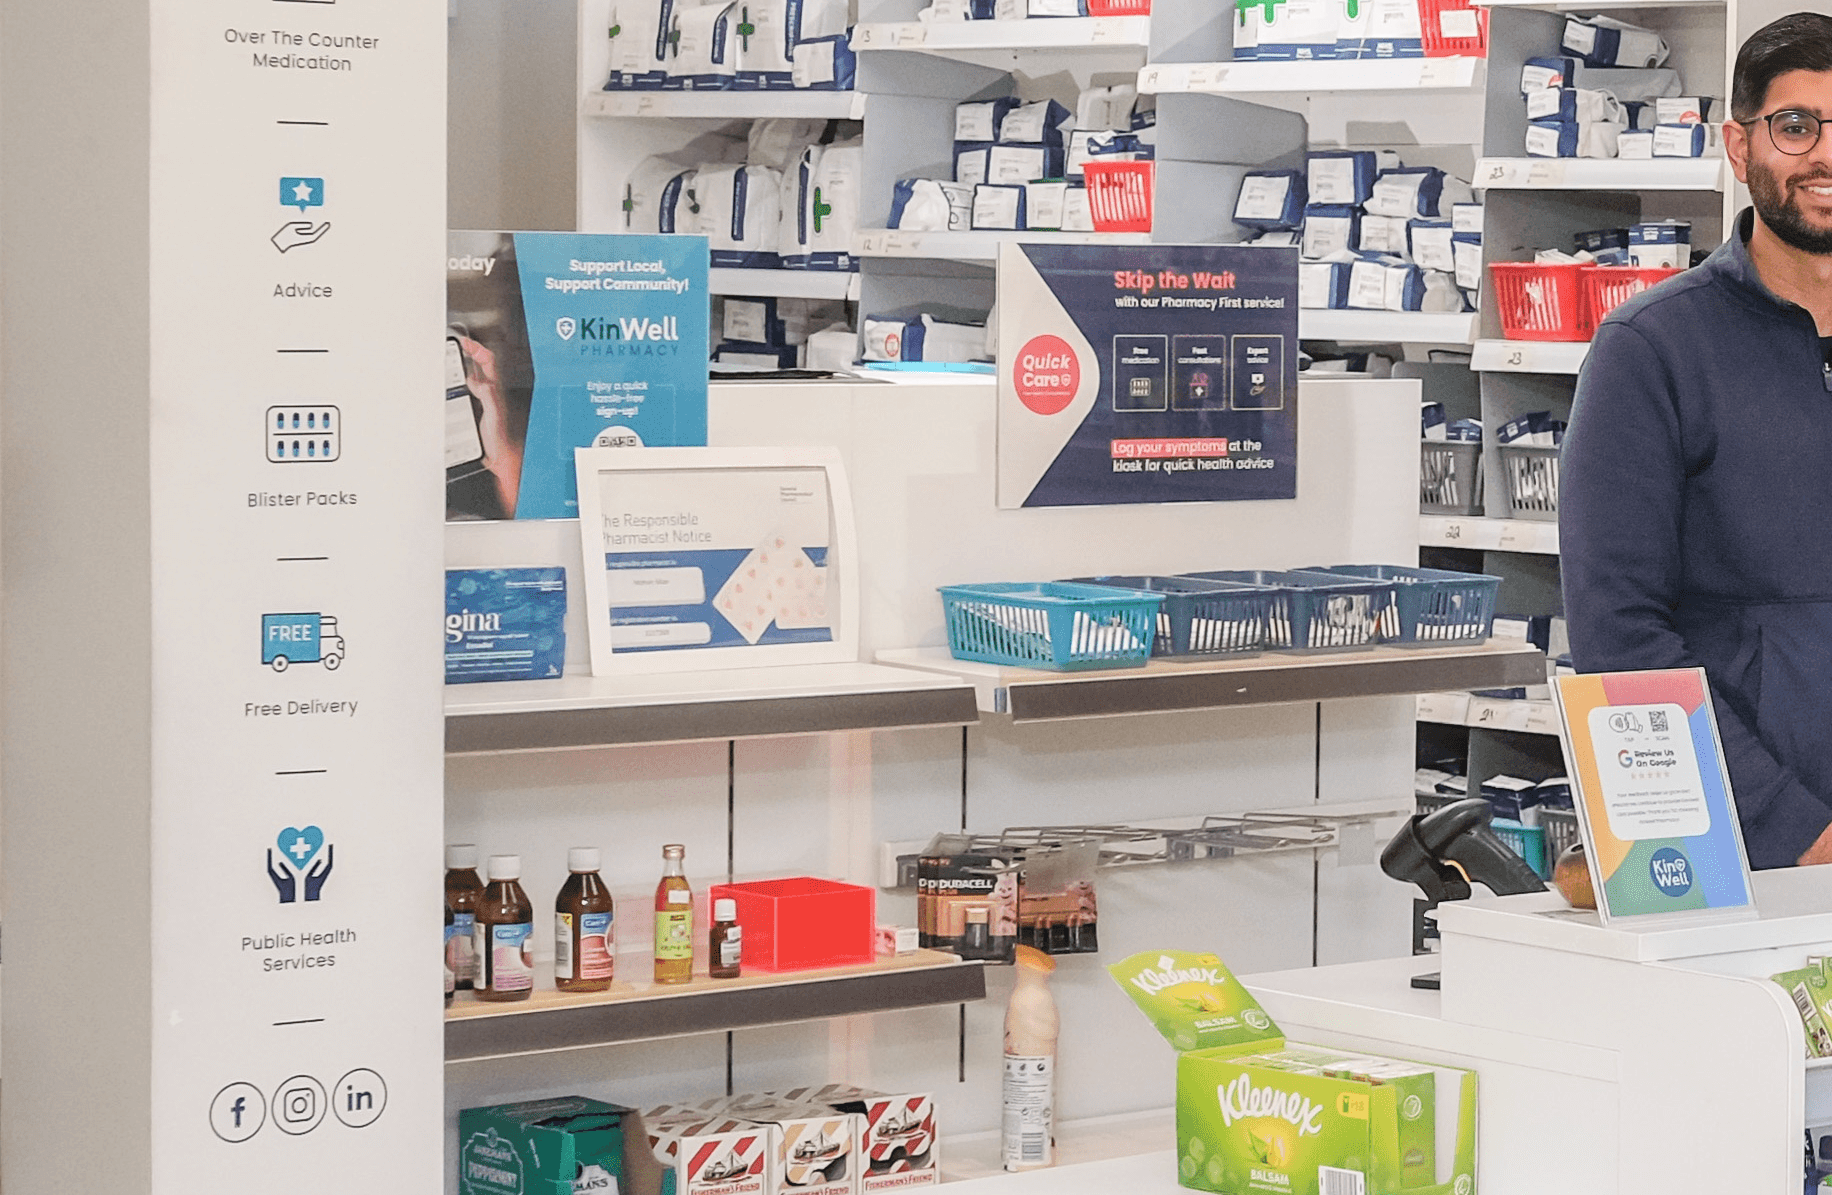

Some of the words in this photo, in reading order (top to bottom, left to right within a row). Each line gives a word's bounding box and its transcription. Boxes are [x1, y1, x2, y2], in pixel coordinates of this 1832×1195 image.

[224, 28, 265, 45] Over
[272, 30, 304, 46] The
[308, 32, 379, 49] Counter
[252, 53, 352, 72] Medication
[449, 255, 496, 276] oday
[569, 260, 626, 275] Support
[627, 260, 666, 274] Local,
[545, 277, 602, 293] Support
[603, 277, 689, 294] Community!
[1114, 270, 1155, 294] Skip
[1159, 271, 1189, 289] the
[1192, 271, 1236, 289] Wait
[273, 283, 333, 299] Advice
[1115, 296, 1139, 308] with
[1141, 299, 1160, 308] our
[1162, 297, 1217, 311] Pharmacy
[1219, 297, 1242, 308] First
[1244, 297, 1285, 309] service!
[581, 316, 679, 341] KinWell
[581, 345, 679, 357] PHARMACY
[1022, 352, 1070, 370] Quick
[1022, 372, 1060, 387] Care
[1113, 441, 1135, 457] Log
[1137, 443, 1163, 457] your
[1165, 440, 1227, 455] symptoms
[1243, 440, 1261, 451] the
[1113, 459, 1142, 472] kiosk
[1145, 459, 1161, 471] for
[1163, 458, 1195, 475] quick
[1197, 458, 1233, 471] health
[1235, 458, 1275, 470] advice
[247, 492, 301, 508] Blister
[306, 490, 358, 507] Packs
[623, 513, 699, 529] Responsible
[673, 530, 711, 543] Notice
[268, 625, 312, 642] FREE
[244, 700, 282, 717] Free
[287, 697, 358, 717] Delivery
[1652, 857, 1678, 874] Kin
[938, 879, 993, 889] DURACELL
[1656, 871, 1690, 887] Well
[241, 933, 295, 952] Public
[300, 928, 356, 947] Health
[262, 953, 336, 973] Services
[1130, 966, 1225, 996] Kleenex
[1217, 1072, 1324, 1137] Kleenex
